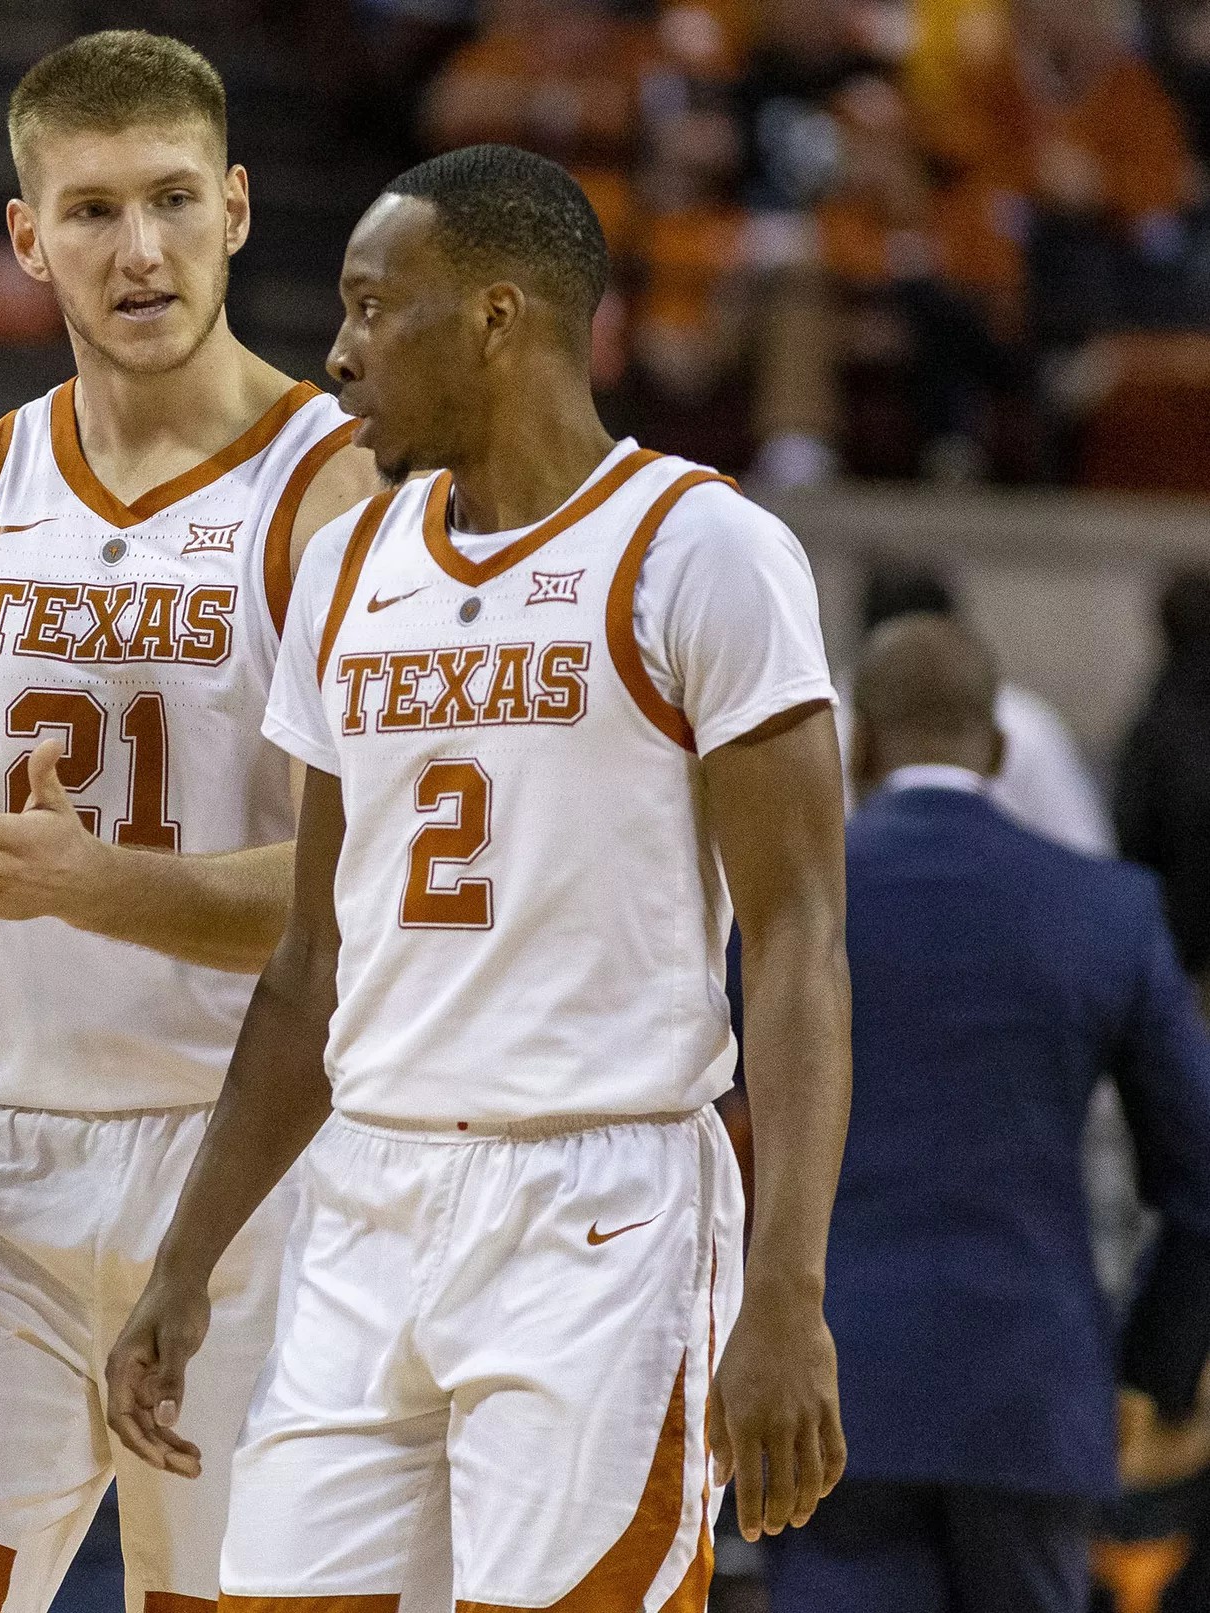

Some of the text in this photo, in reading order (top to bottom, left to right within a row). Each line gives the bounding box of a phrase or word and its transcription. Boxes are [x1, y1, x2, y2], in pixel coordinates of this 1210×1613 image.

[183, 522, 241, 555] XII
[527, 570, 583, 605] XII
[337, 641, 591, 736] TEXAS
[5, 687, 181, 855] 21
[398, 757, 493, 930] 2
